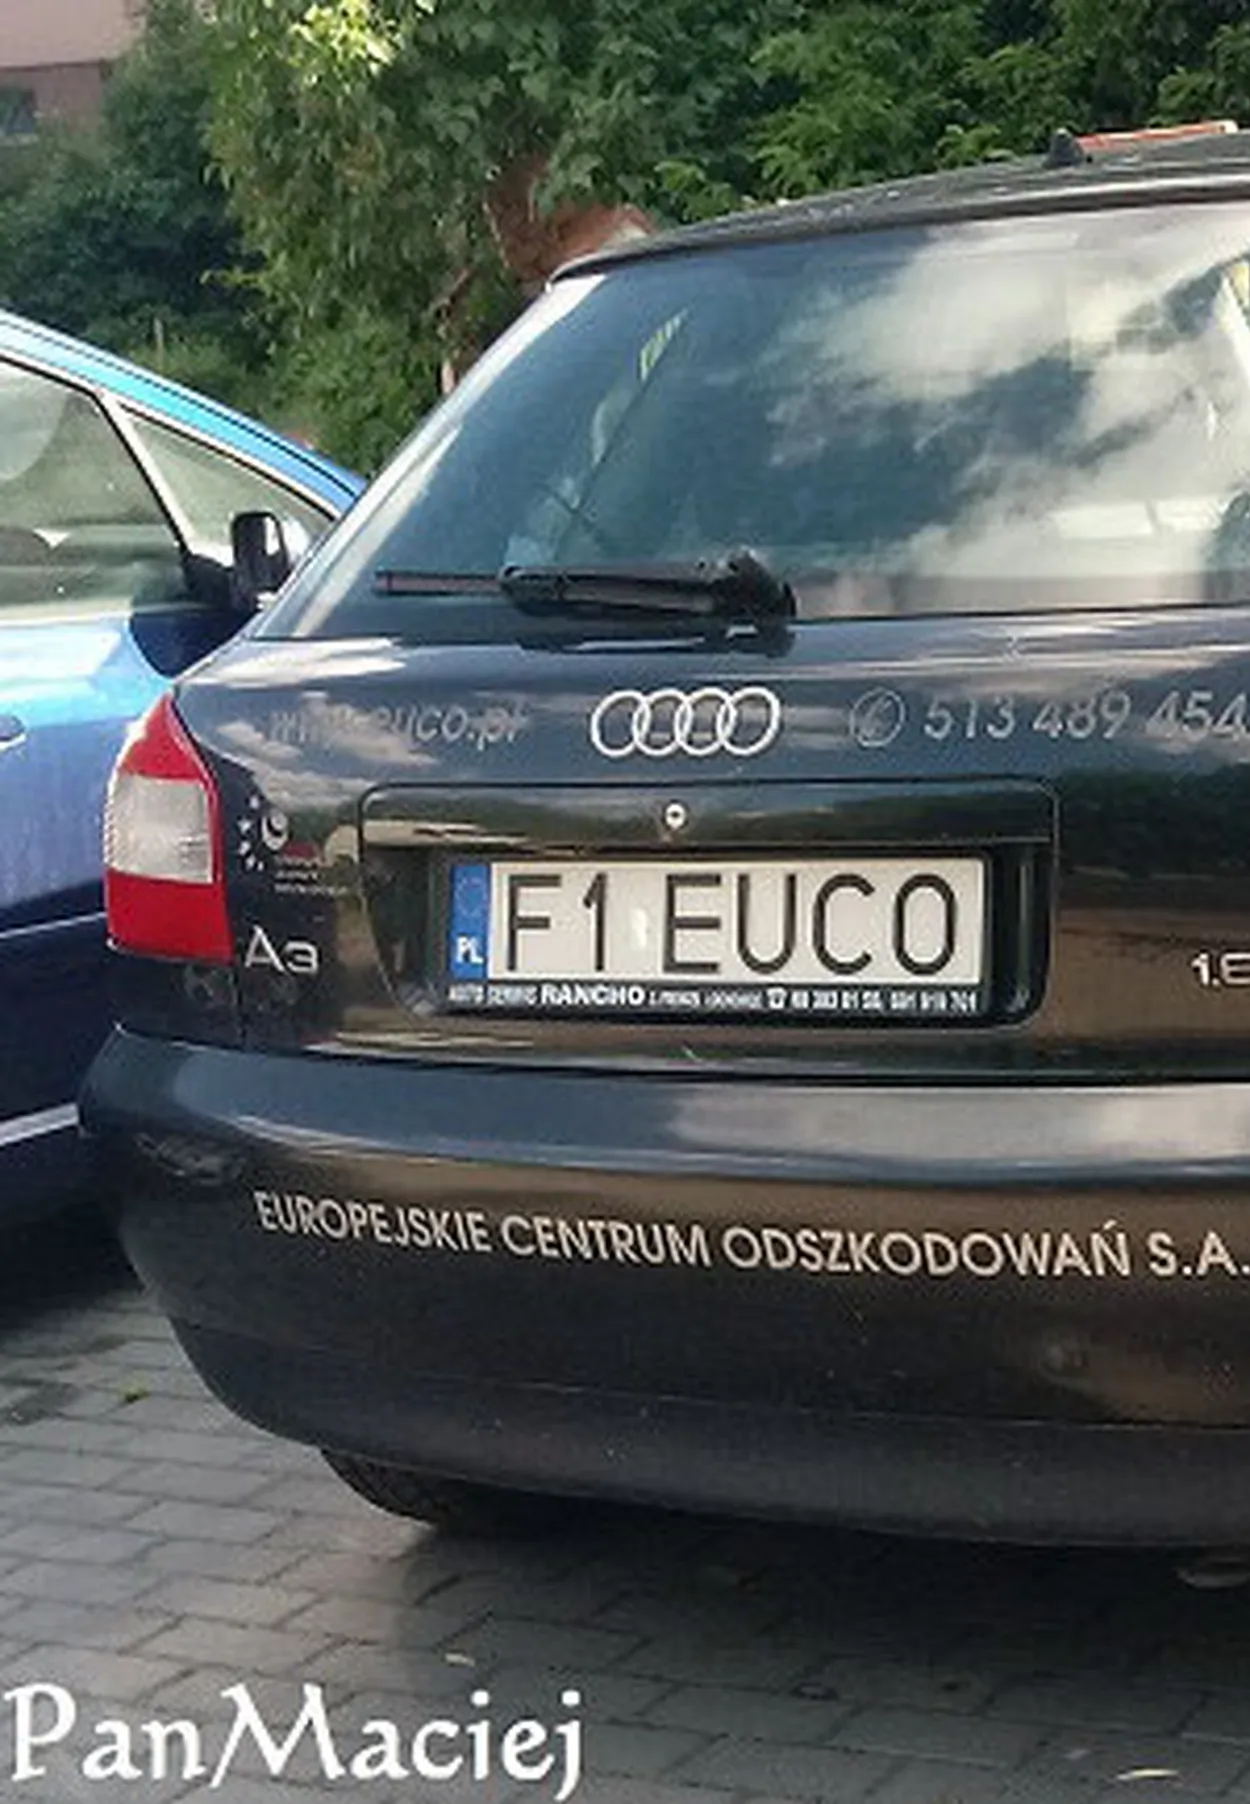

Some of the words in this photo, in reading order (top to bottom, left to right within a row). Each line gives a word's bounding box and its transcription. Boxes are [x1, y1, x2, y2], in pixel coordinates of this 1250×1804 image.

[268, 697, 528, 750] wweuco.pl
[923, 698, 1016, 739] 513
[1032, 691, 1132, 739] 489
[506, 872, 607, 972] F1
[663, 872, 959, 975] EUCO
[245, 925, 318, 972] A3
[455, 936, 484, 964] PL
[540, 984, 647, 1007] RANCHO
[254, 1191, 493, 1253] EUROPEJSKIE
[500, 1214, 712, 1267] CENTRUM
[721, 1220, 1131, 1277] ODSZKODOWAŃ
